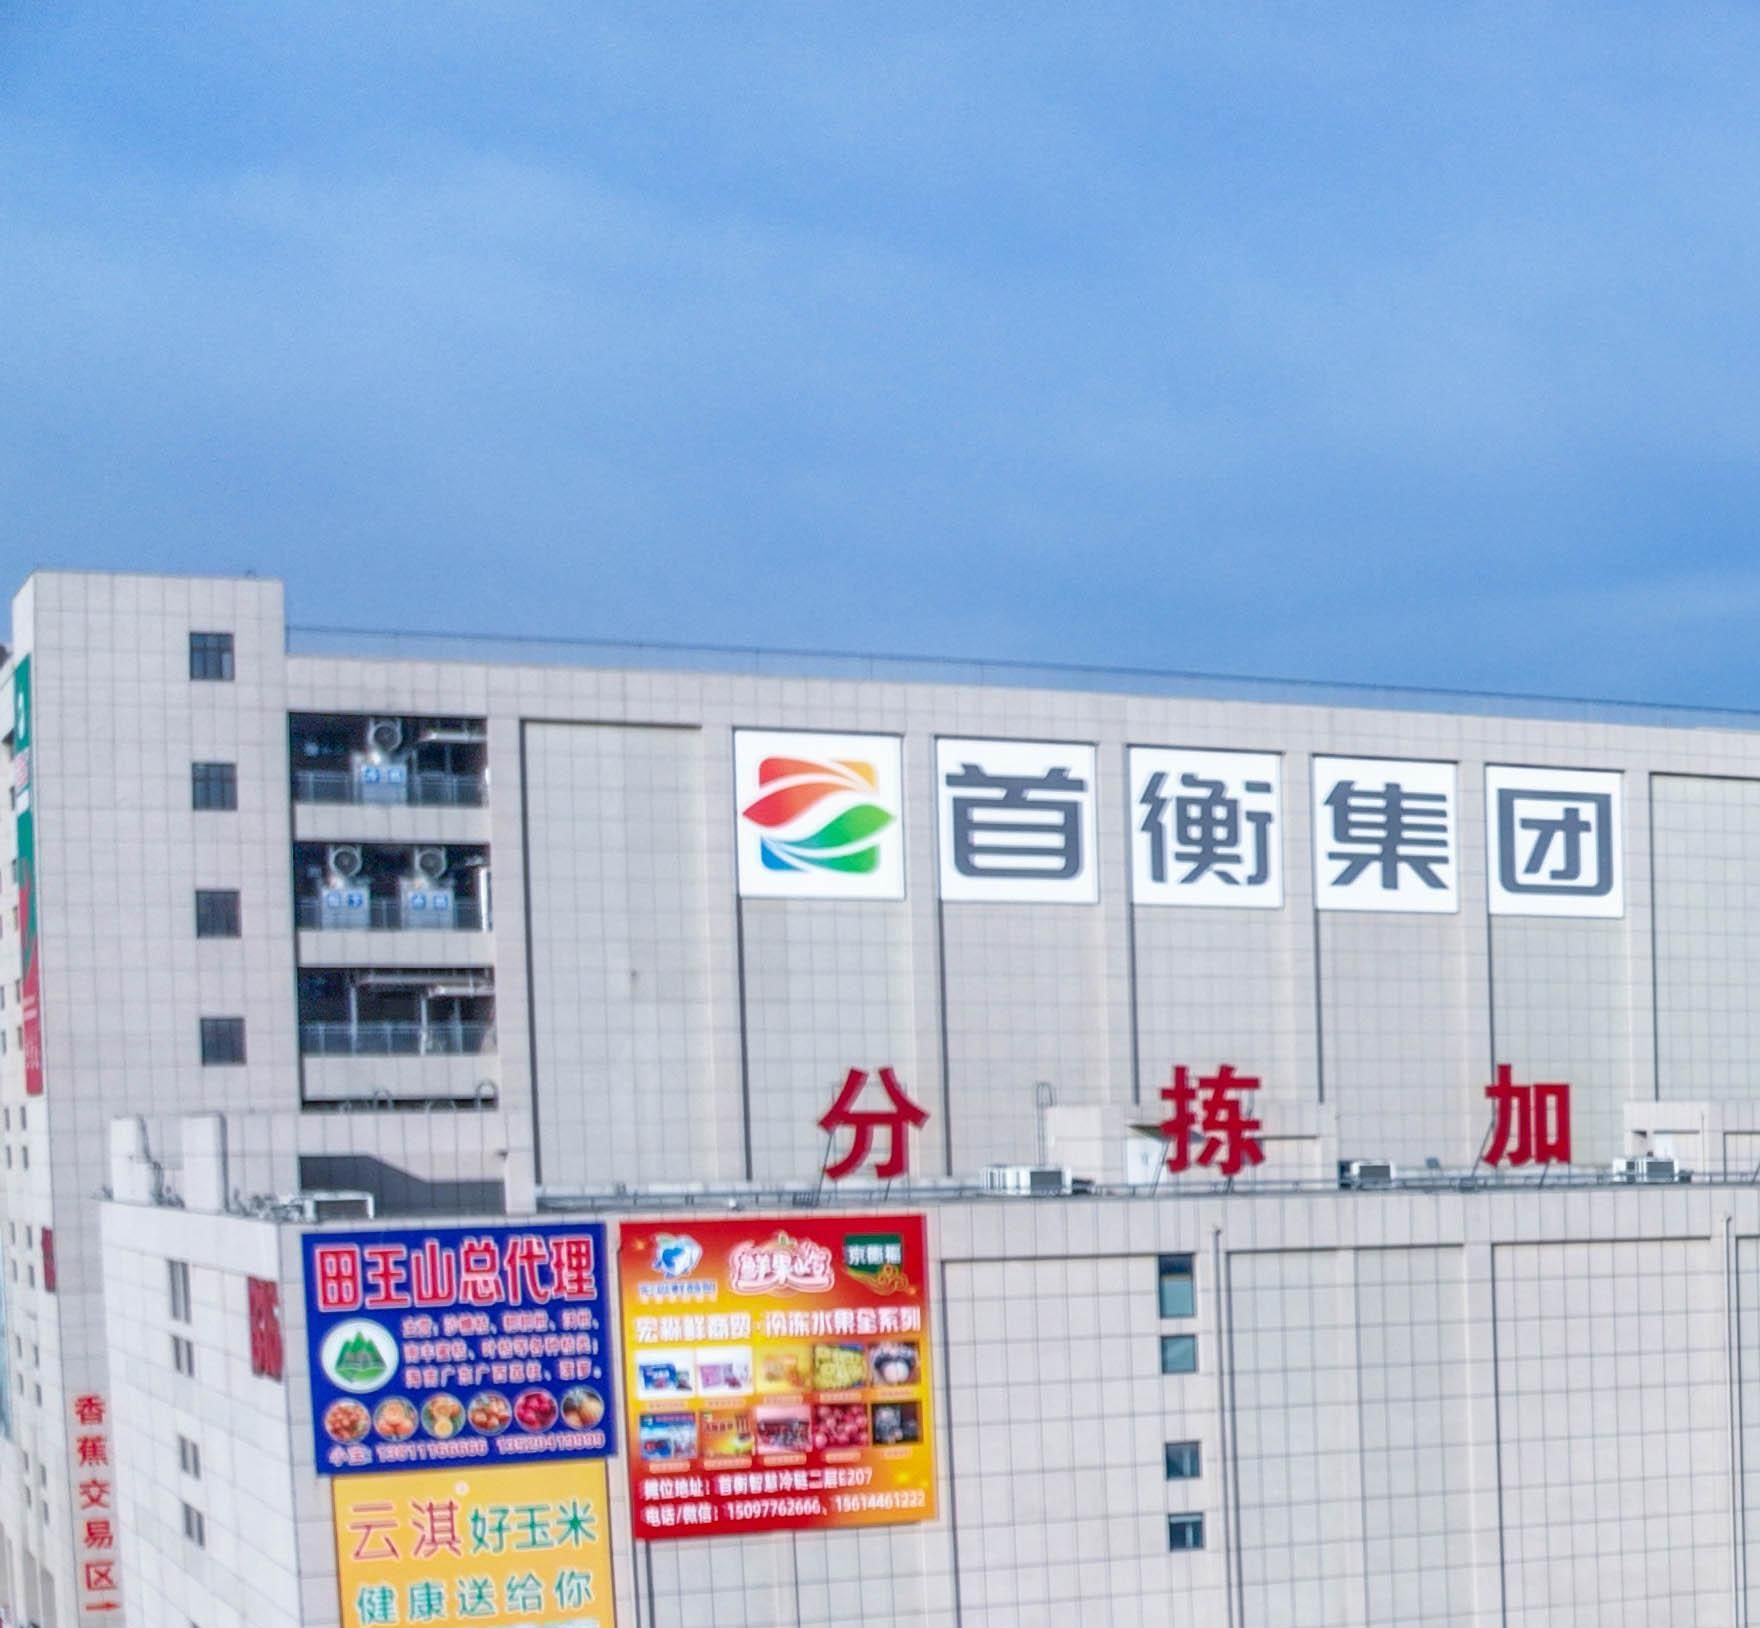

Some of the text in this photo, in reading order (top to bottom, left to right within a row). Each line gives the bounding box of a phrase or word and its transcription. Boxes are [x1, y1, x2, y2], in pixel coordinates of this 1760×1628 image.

[946, 762, 1614, 896] 首衡集团
[74, 1394, 117, 1590] 香蕉交易区
[347, 1498, 599, 1562] 云淇好玉米
[355, 1569, 594, 1627] 健康送给你
